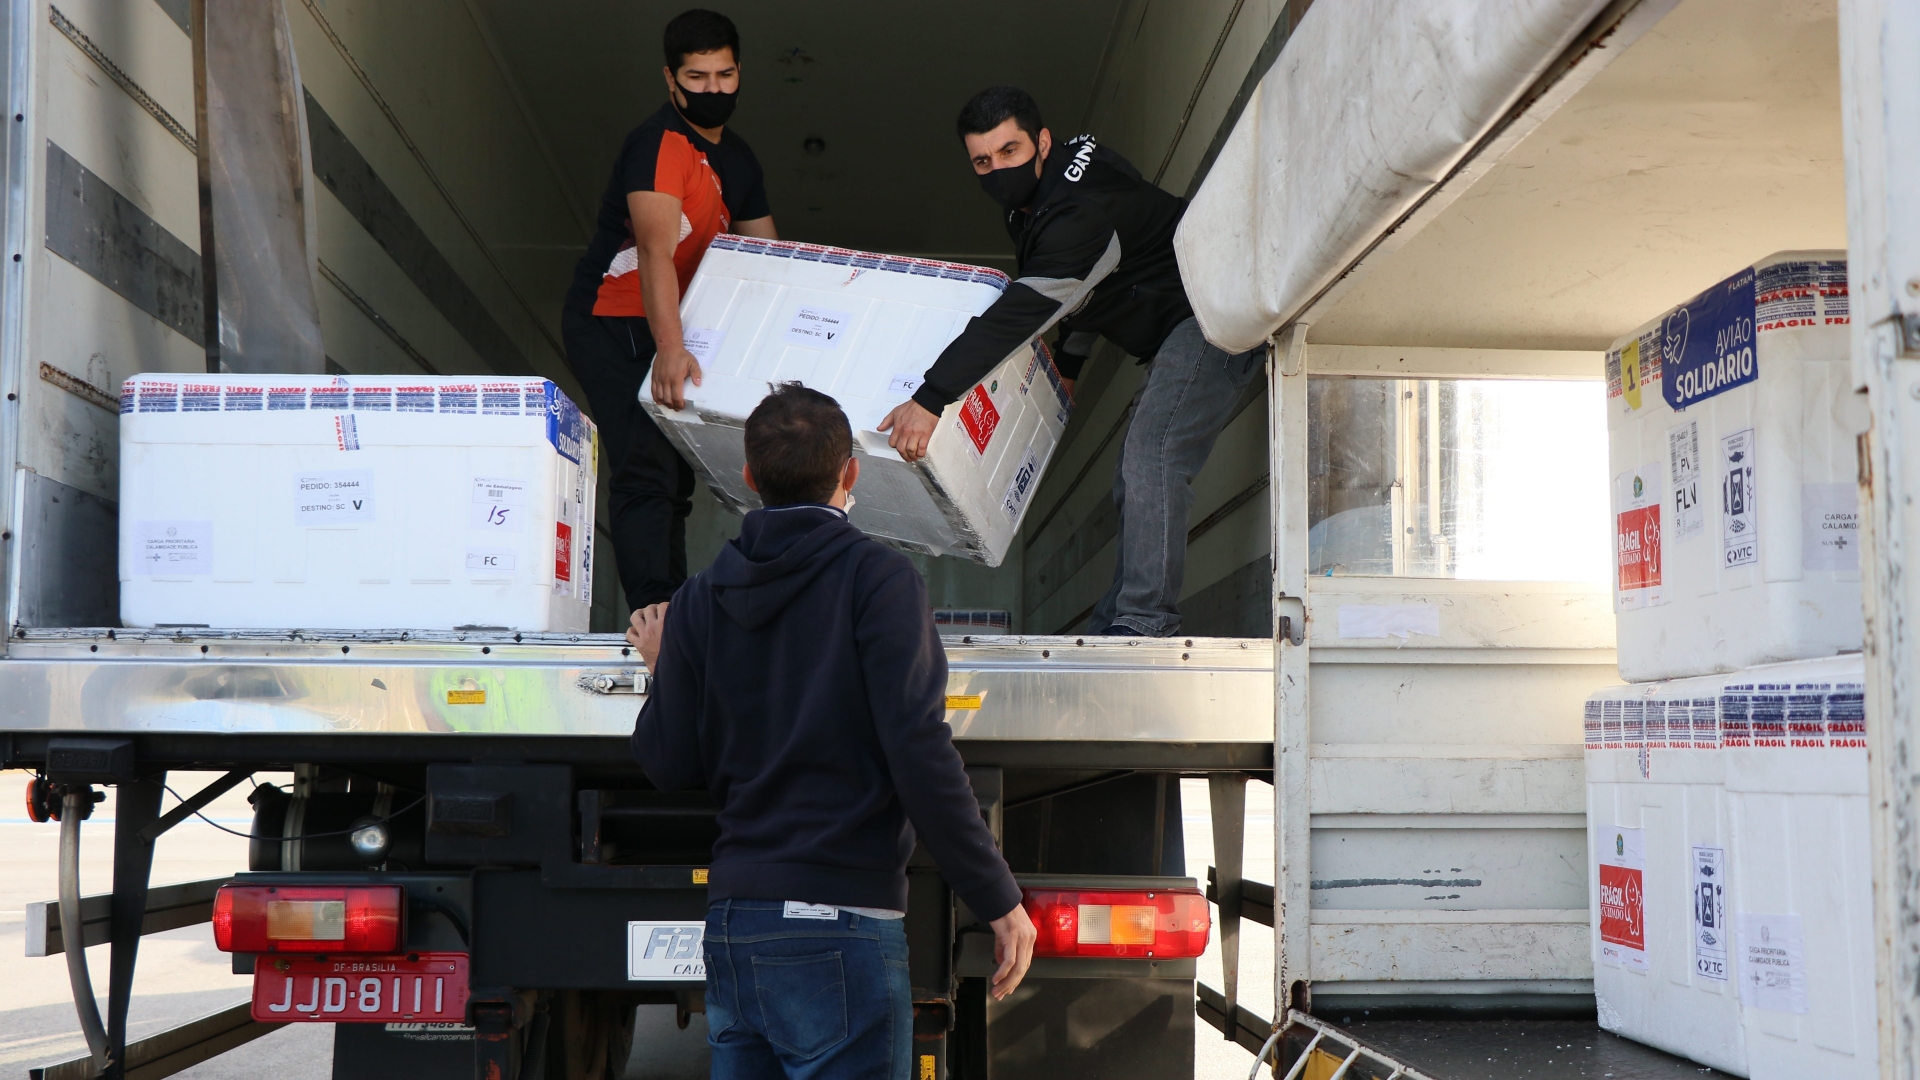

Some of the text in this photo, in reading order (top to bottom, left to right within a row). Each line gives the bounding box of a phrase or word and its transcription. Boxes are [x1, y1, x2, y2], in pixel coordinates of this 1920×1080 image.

[1732, 274, 1753, 290] LATAM
[827, 332, 835, 340] V
[1715, 316, 1751, 355] AVIÃO
[1627, 364, 1636, 392] 1
[1676, 347, 1752, 403] SOLIDÁRIO
[903, 381, 915, 389] FC
[300, 481, 360, 490] PEDIDO: 354444
[301, 504, 334, 512] DESTINO:
[352, 499, 363, 511] V
[487, 505, 510, 525] 15
[1824, 513, 1852, 521] CARGA
[1619, 528, 1641, 553] FRÁGIL
[1737, 546, 1753, 558] VTC
[484, 556, 498, 566] FC
[1754, 736, 1786, 747] FRÁGIL
[1791, 736, 1825, 748] FRÁGIL
[1830, 736, 1867, 748] FRÁGIL
[1601, 881, 1624, 907] FRÁGIL
[673, 964, 707, 975] CAR
